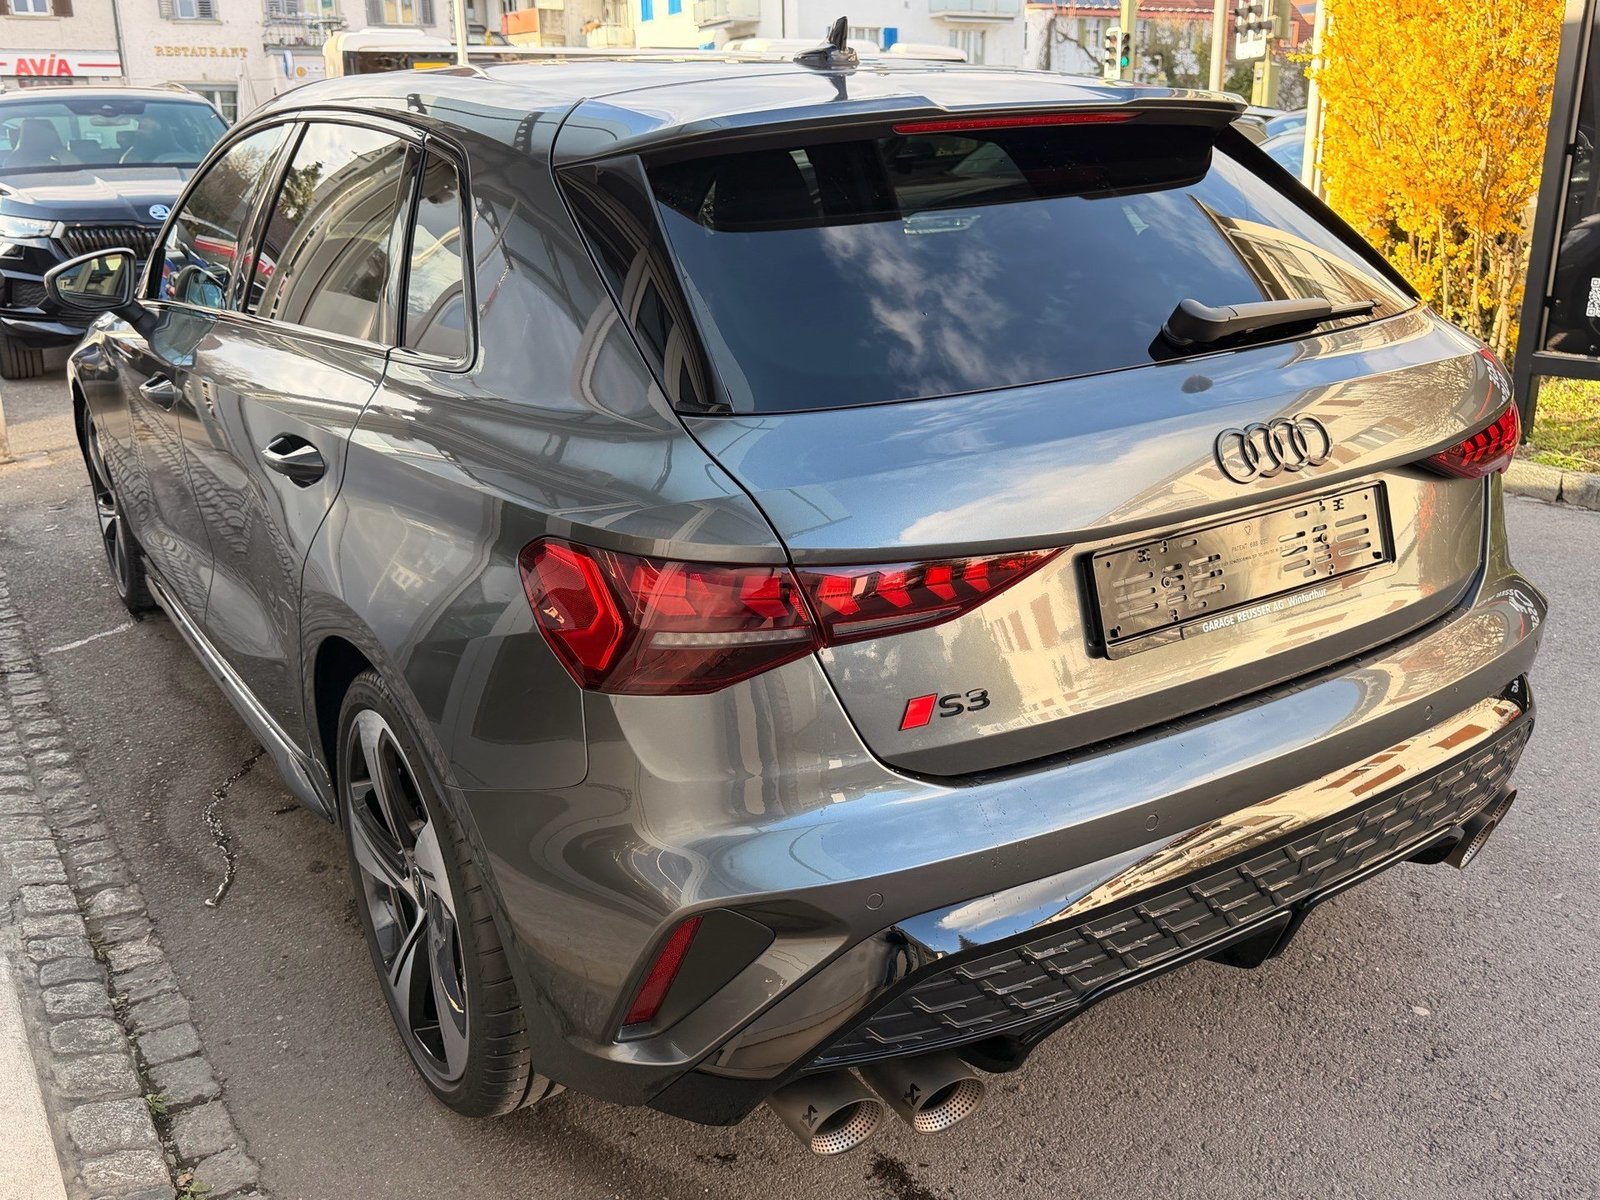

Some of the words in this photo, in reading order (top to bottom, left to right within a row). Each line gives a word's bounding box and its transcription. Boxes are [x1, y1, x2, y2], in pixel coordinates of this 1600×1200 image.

[154, 46, 248, 58] RESTAURANT
[1202, 615, 1235, 633] GARAGE
[1237, 605, 1271, 623] REUSSER
[1272, 599, 1284, 612] AG
[1287, 588, 1327, 607] Winterthur
[938, 687, 991, 718] S3
